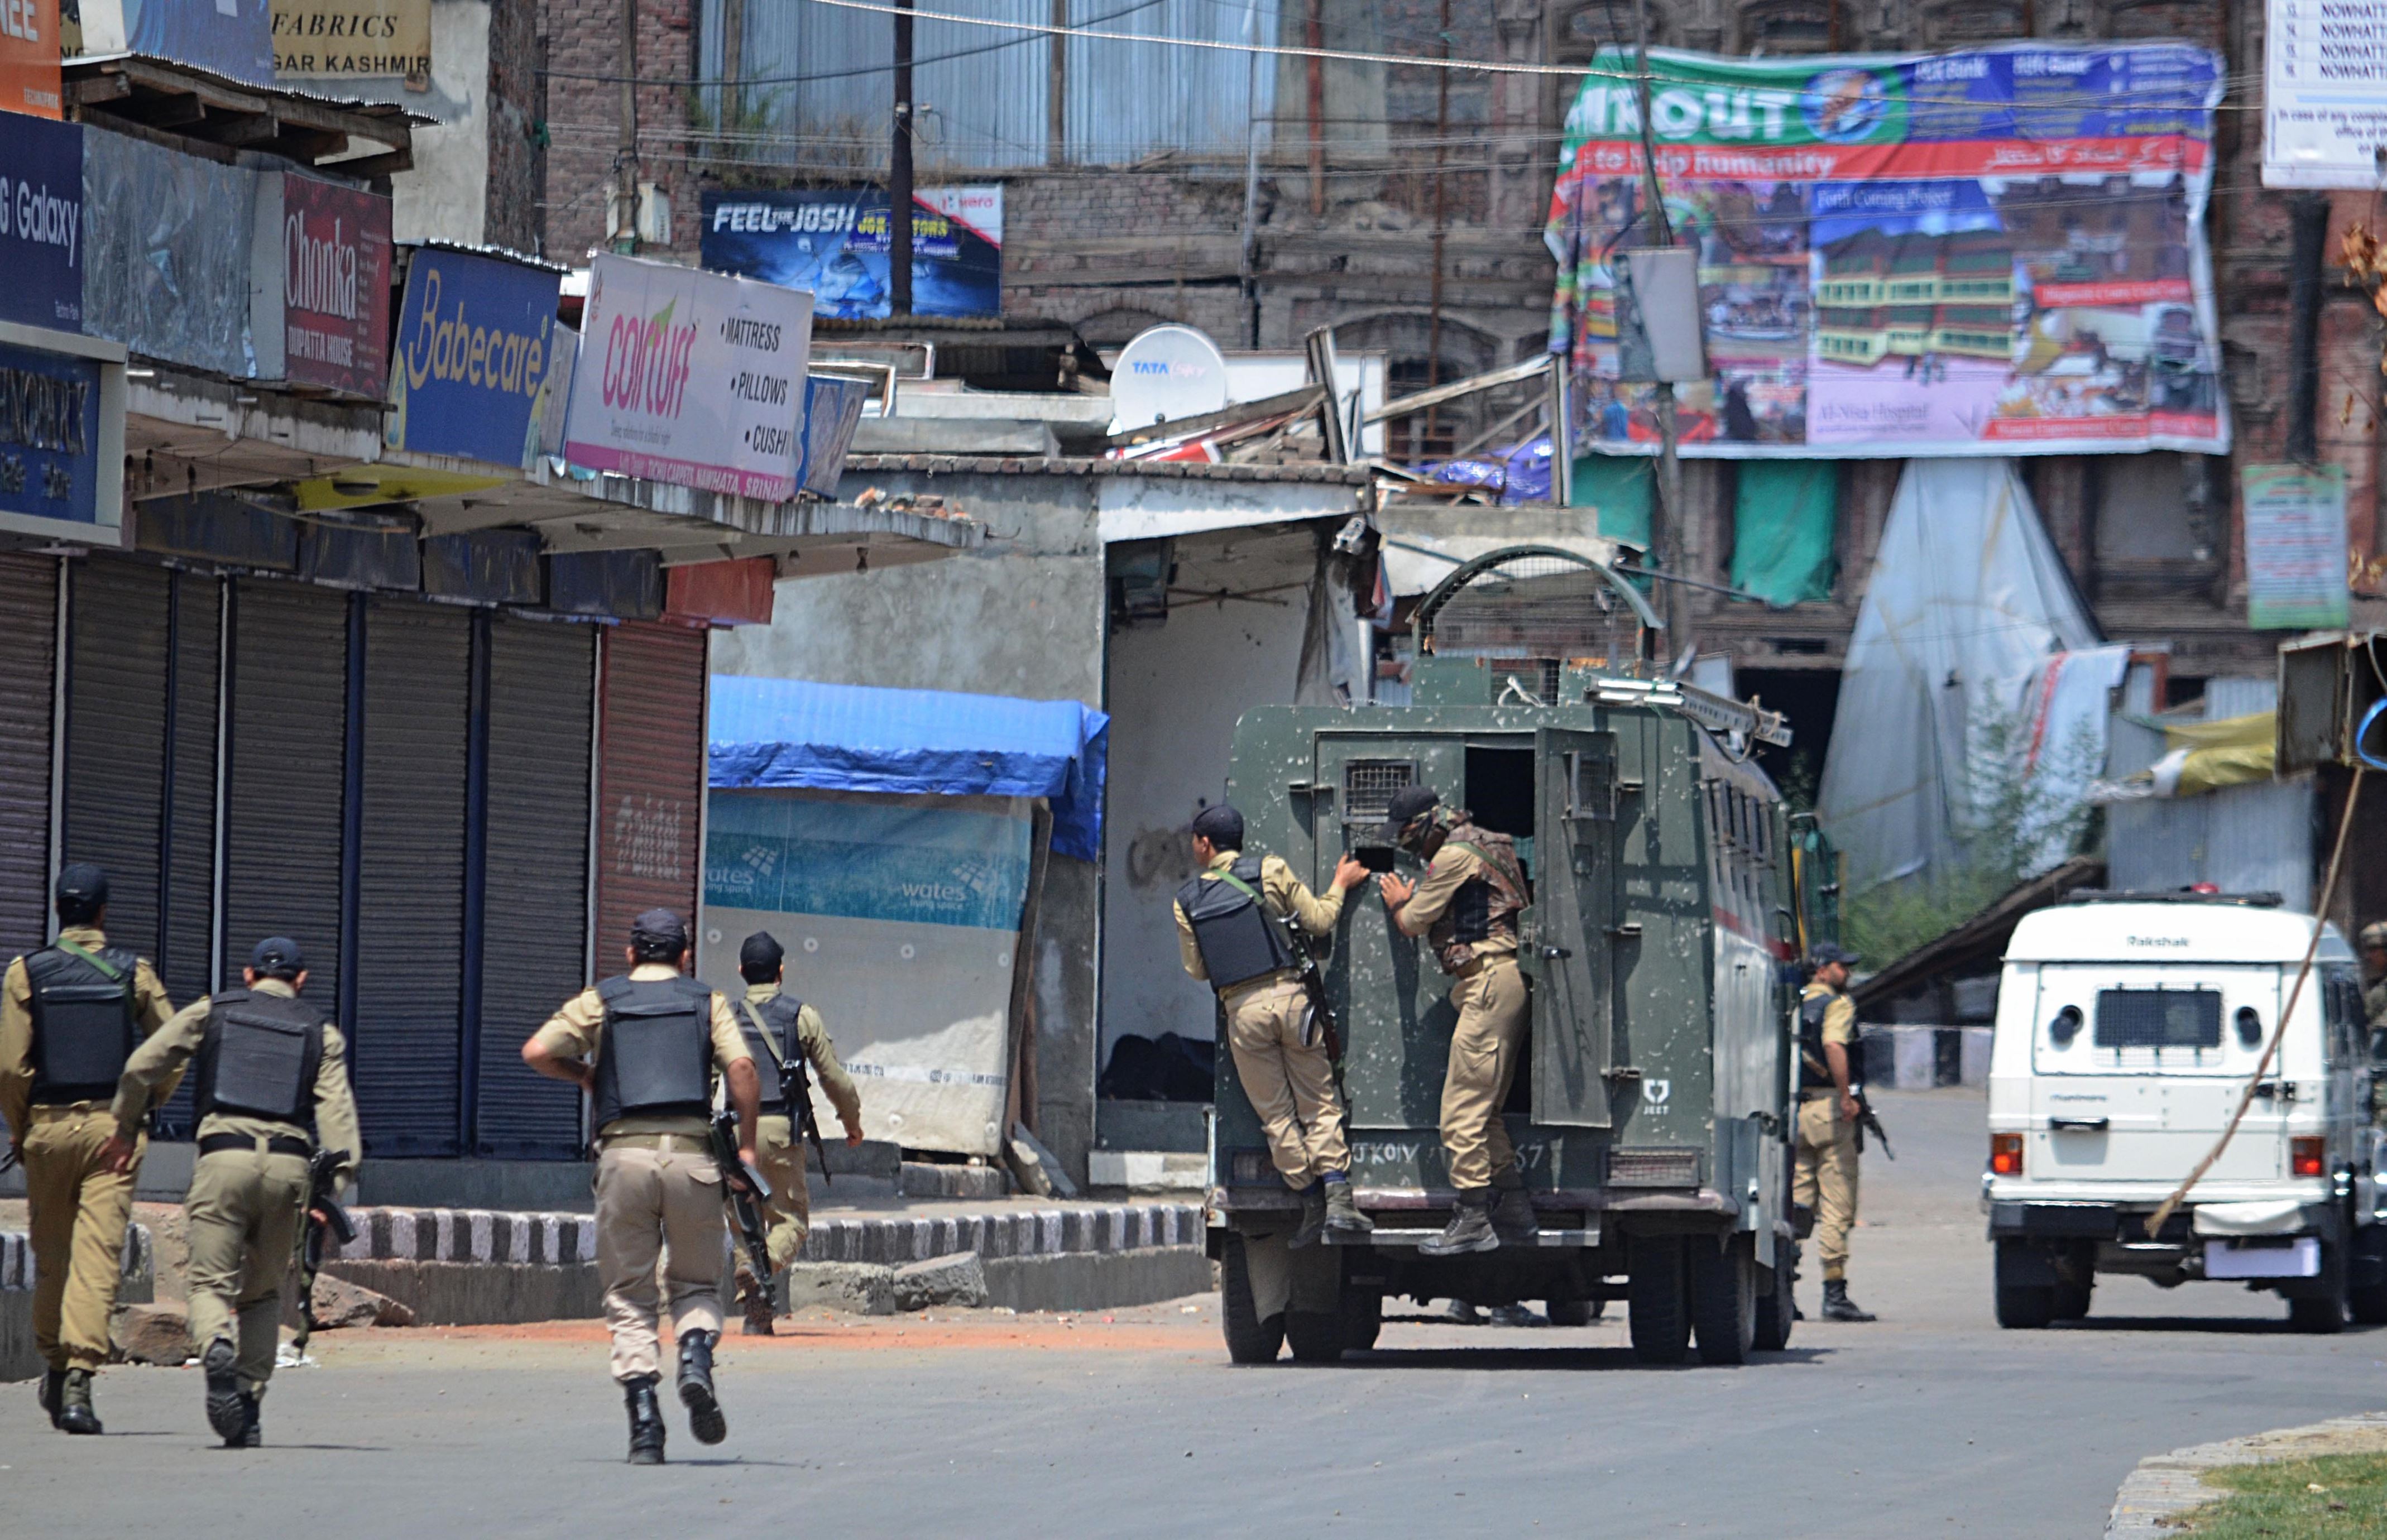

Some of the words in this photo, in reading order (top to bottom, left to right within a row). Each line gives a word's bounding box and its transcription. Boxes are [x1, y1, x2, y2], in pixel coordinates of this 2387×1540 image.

[272, 12, 398, 37] FABRICS
[326, 55, 430, 75] KASHMIR
[1629, 148, 1687, 179] hlp
[1693, 152, 1834, 179] humanity
[17, 181, 78, 268] Galaxy
[713, 203, 778, 233] FEEL
[790, 203, 857, 233] JOSH
[285, 209, 356, 320] Chonka
[288, 325, 325, 362] DUPATTA
[327, 334, 353, 368] HOUSE
[408, 269, 543, 398] Babecare
[726, 317, 780, 353] MATTRESS
[1132, 363, 1169, 374] TATA
[737, 372, 788, 406] PILLOWS
[902, 882, 966, 902] wates
[2127, 935, 2189, 948] Rakshak
